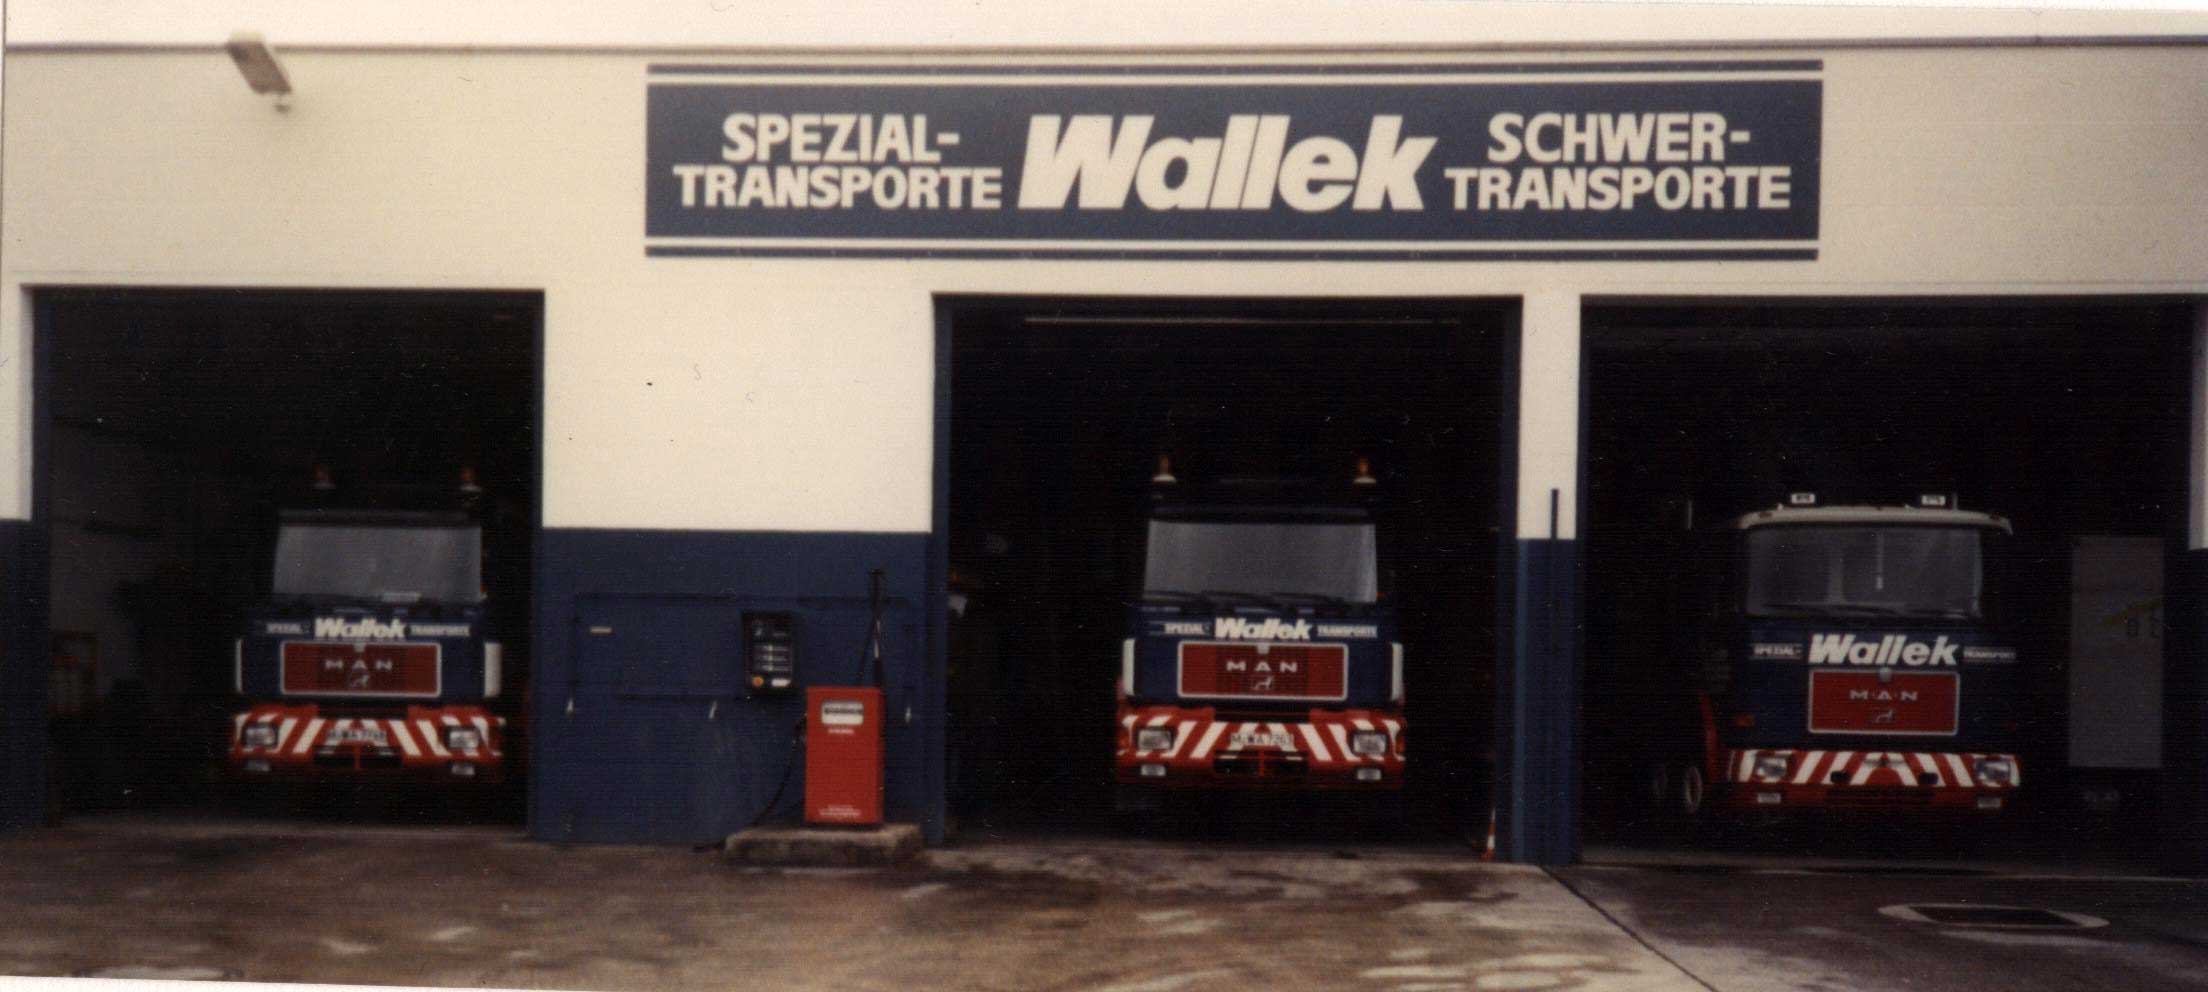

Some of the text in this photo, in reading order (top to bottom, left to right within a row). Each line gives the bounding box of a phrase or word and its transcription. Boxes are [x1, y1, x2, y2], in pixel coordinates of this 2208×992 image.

[722, 112, 960, 163] SPEZIAL-
[1487, 112, 1751, 163] SCHWER-
[1017, 113, 1438, 213] Wallek
[672, 164, 1003, 210] TRANSPORTE
[1444, 165, 1791, 211] TRANSPORTE
[314, 617, 408, 639] Wallek
[1214, 616, 1315, 640] Wallek
[1808, 633, 1960, 666] Wallek
